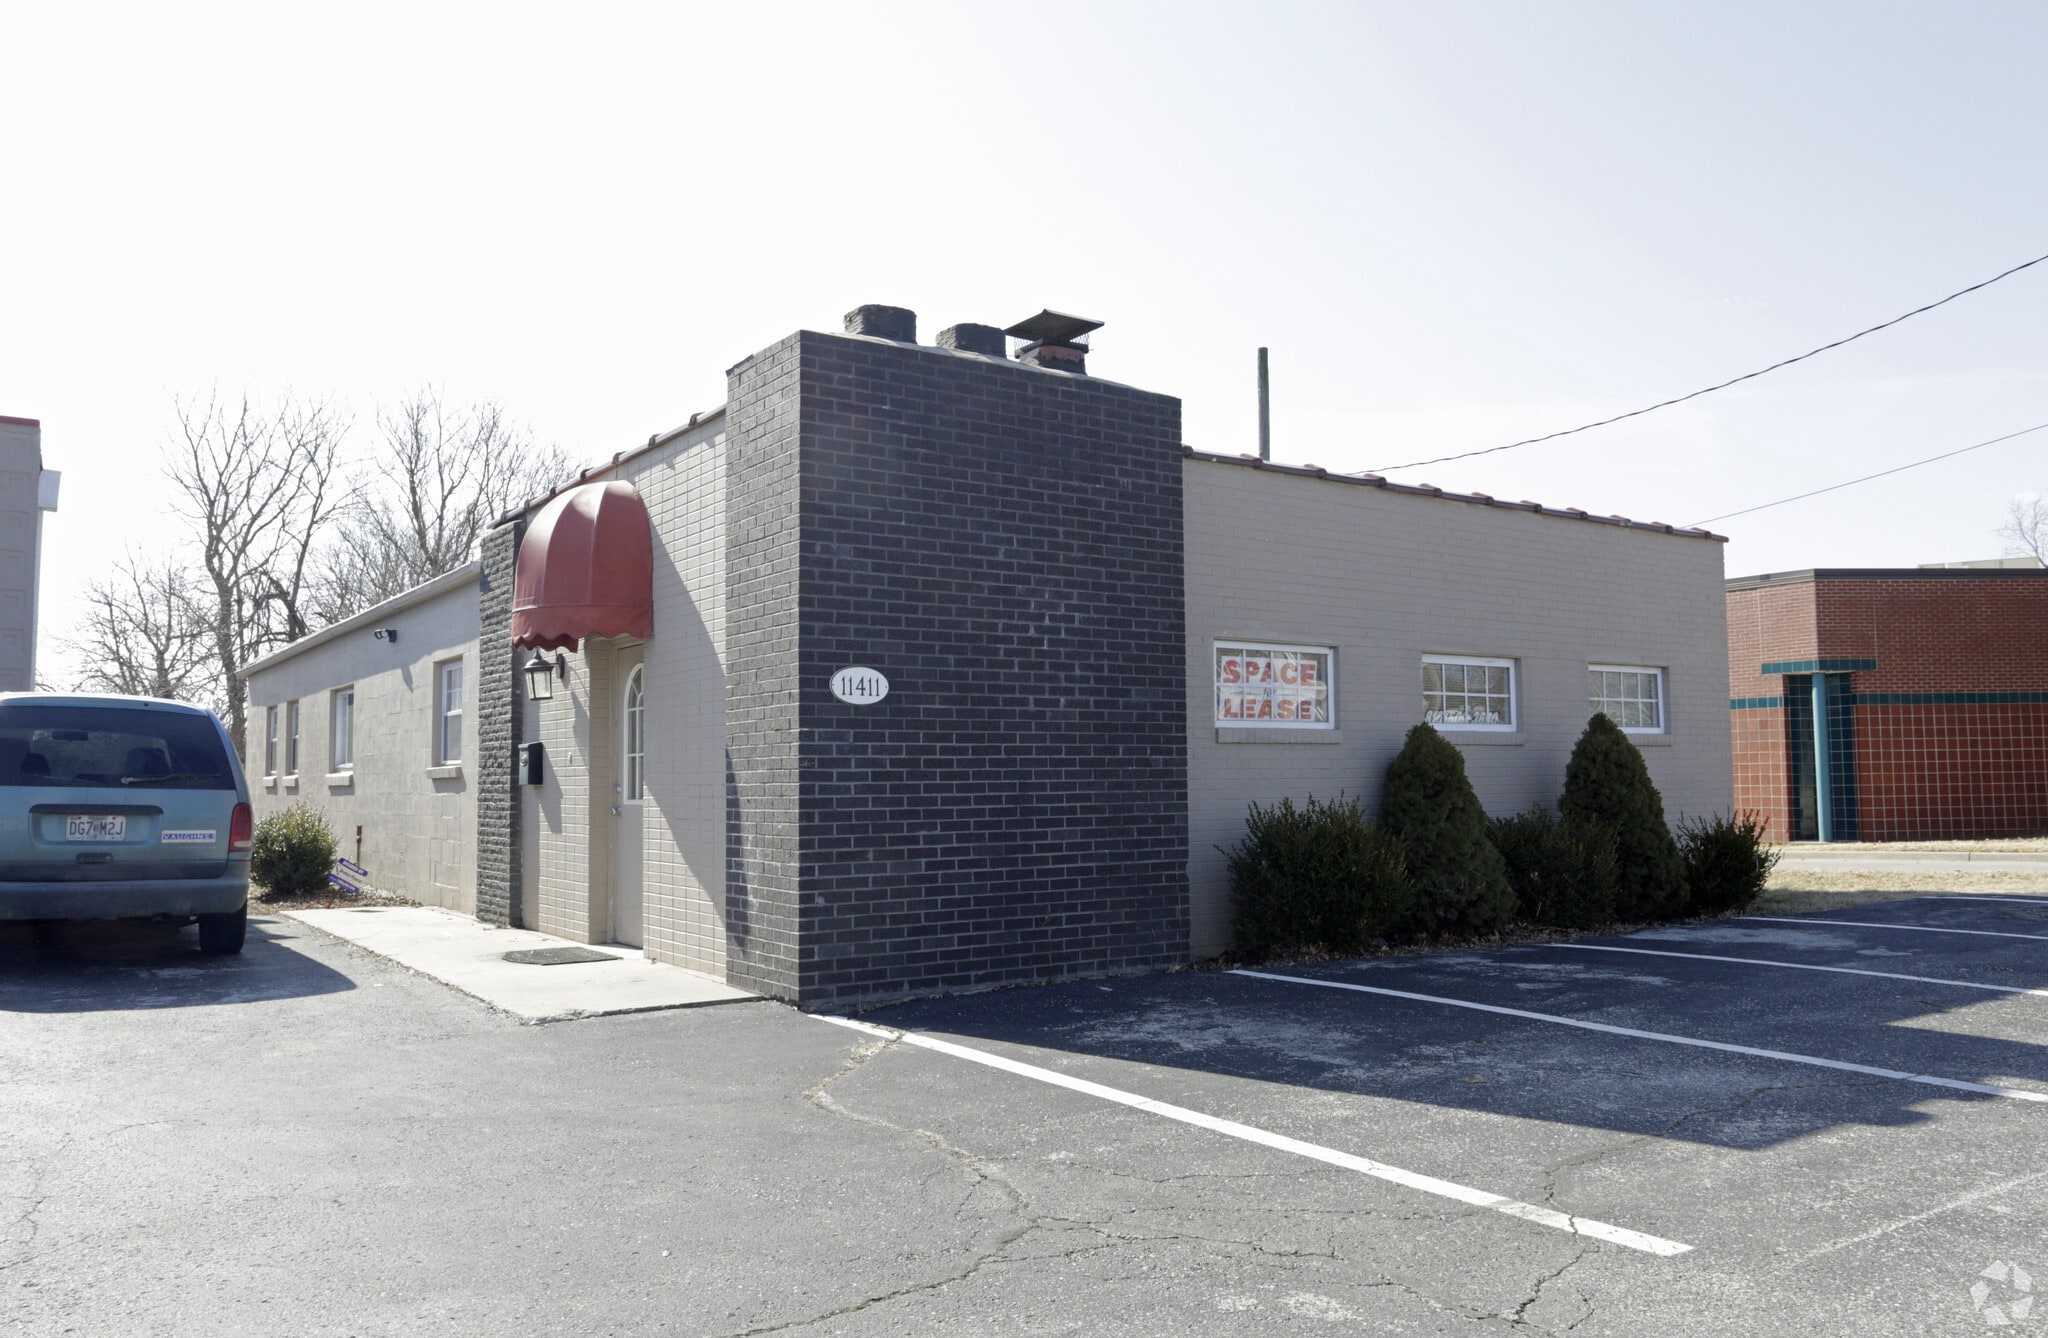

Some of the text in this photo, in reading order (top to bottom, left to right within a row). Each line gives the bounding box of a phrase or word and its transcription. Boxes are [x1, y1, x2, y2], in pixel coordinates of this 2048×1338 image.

[1223, 660, 1316, 687] SPACE
[841, 675, 880, 697] 11411
[1223, 698, 1312, 720] LEASE
[69, 821, 123, 836] DG7 M2J
